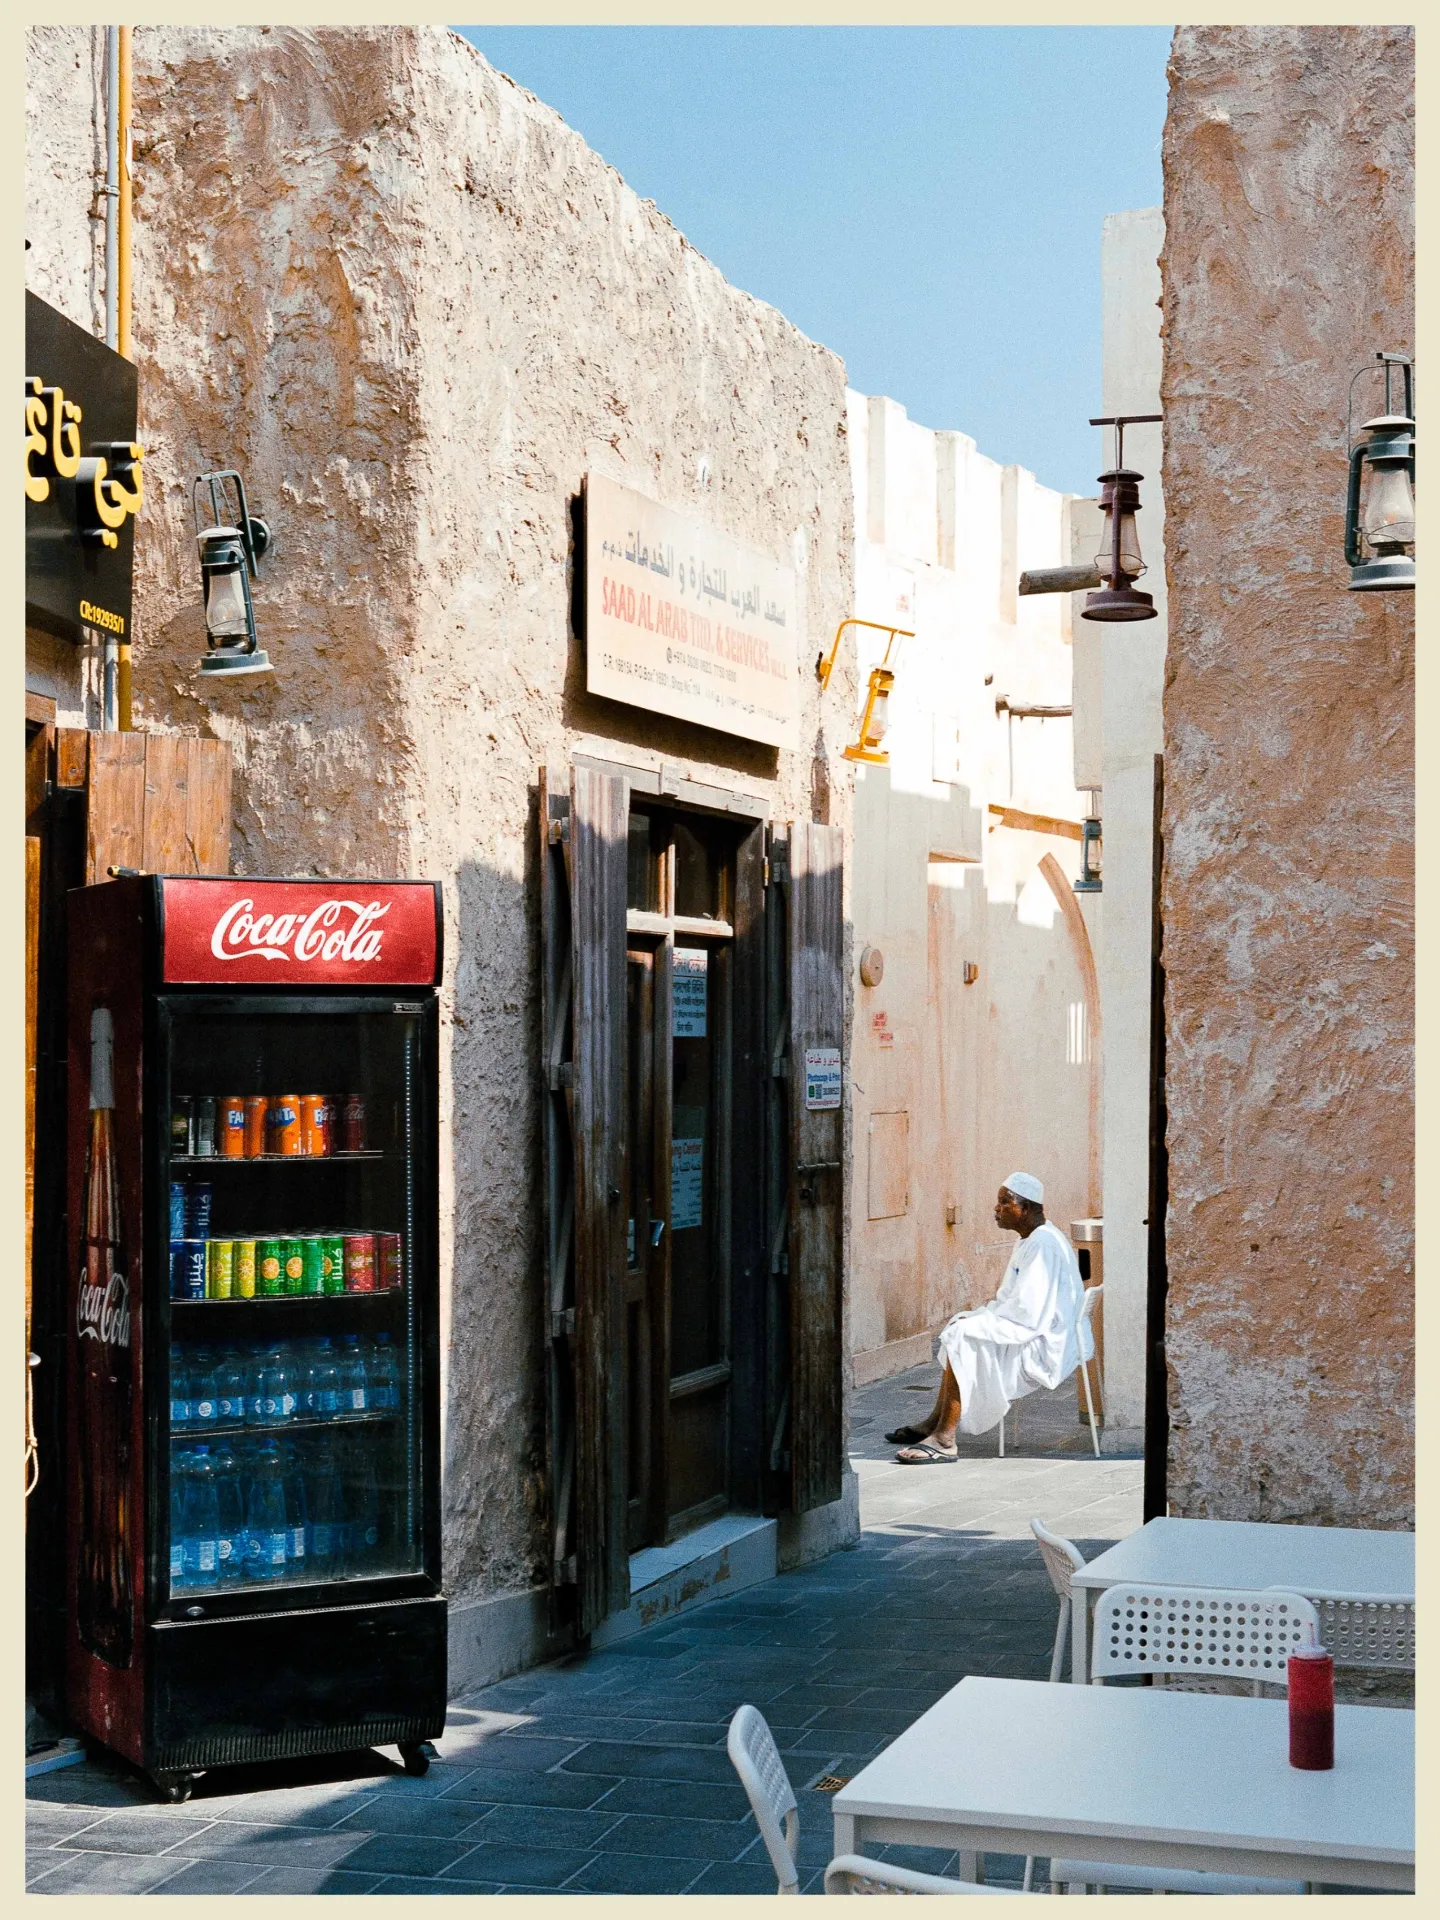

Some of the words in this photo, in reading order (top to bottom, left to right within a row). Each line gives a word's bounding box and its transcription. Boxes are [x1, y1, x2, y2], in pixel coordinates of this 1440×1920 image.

[624, 529, 674, 578] الخدمات
[689, 555, 727, 607] للتجارة
[601, 575, 636, 624] SAAD
[637, 591, 654, 632] AL
[655, 599, 689, 643] ARAB
[716, 623, 724, 657] &
[724, 625, 769, 672] SERVICES
[731, 583, 760, 620] العرب
[210, 898, 392, 962] Coca-Cola
[76, 1266, 131, 1348] Coca-Cola
